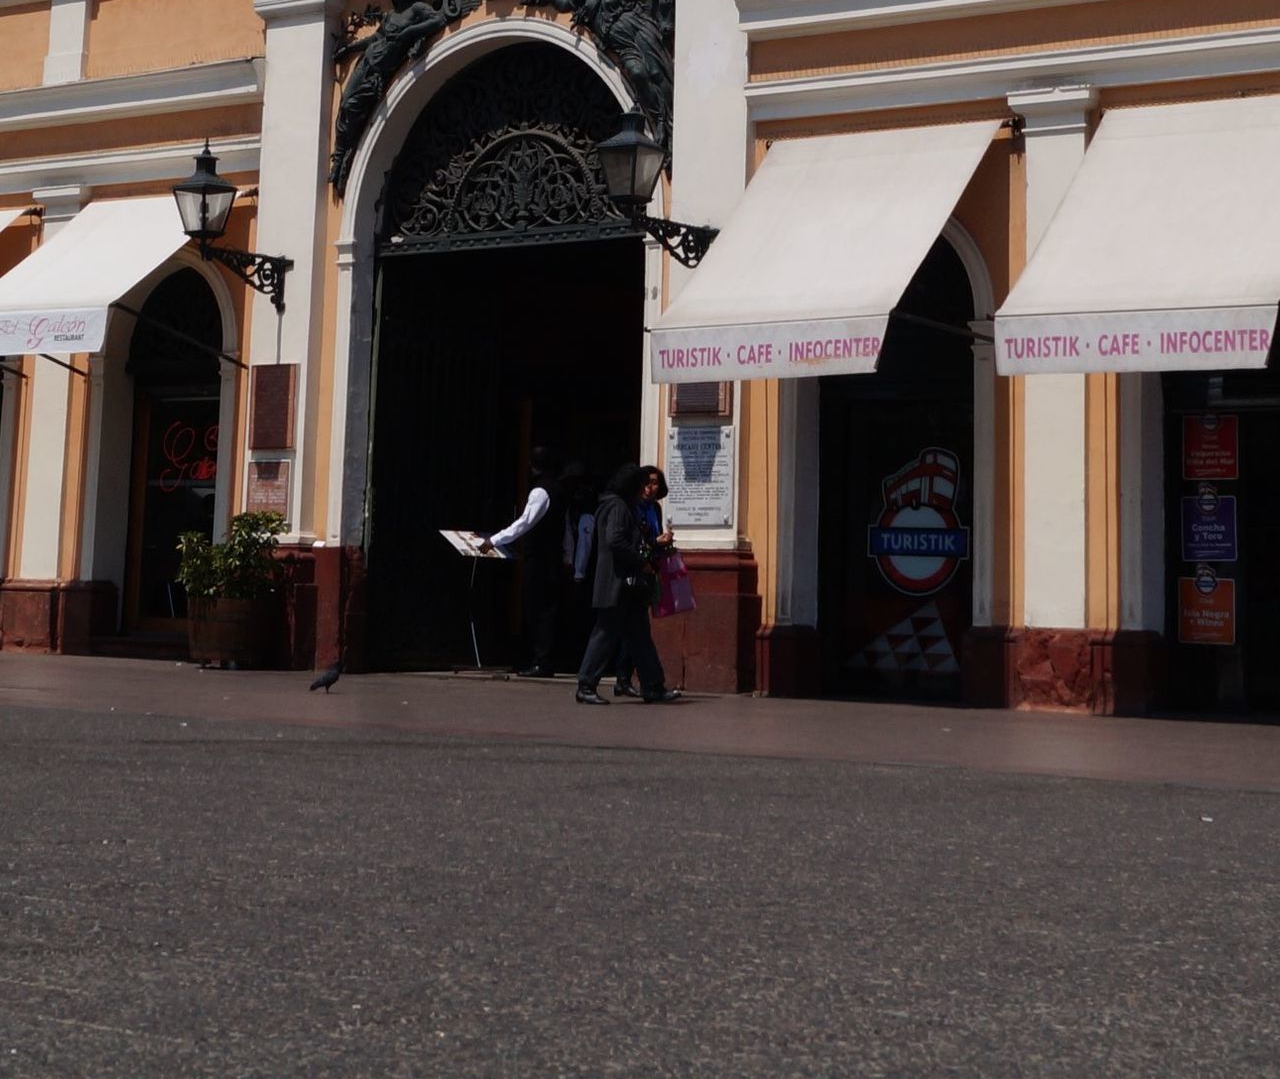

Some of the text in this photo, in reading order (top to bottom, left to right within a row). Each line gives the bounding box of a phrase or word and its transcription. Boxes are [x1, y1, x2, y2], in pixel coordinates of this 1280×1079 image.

[658, 336, 881, 370] TURISTIK CAFE INFOCENTER
[1004, 329, 1272, 359] TURISTIK CAFE INFOCENTER
[1191, 523, 1226, 532] Concha
[880, 532, 956, 551] TURISTIK
